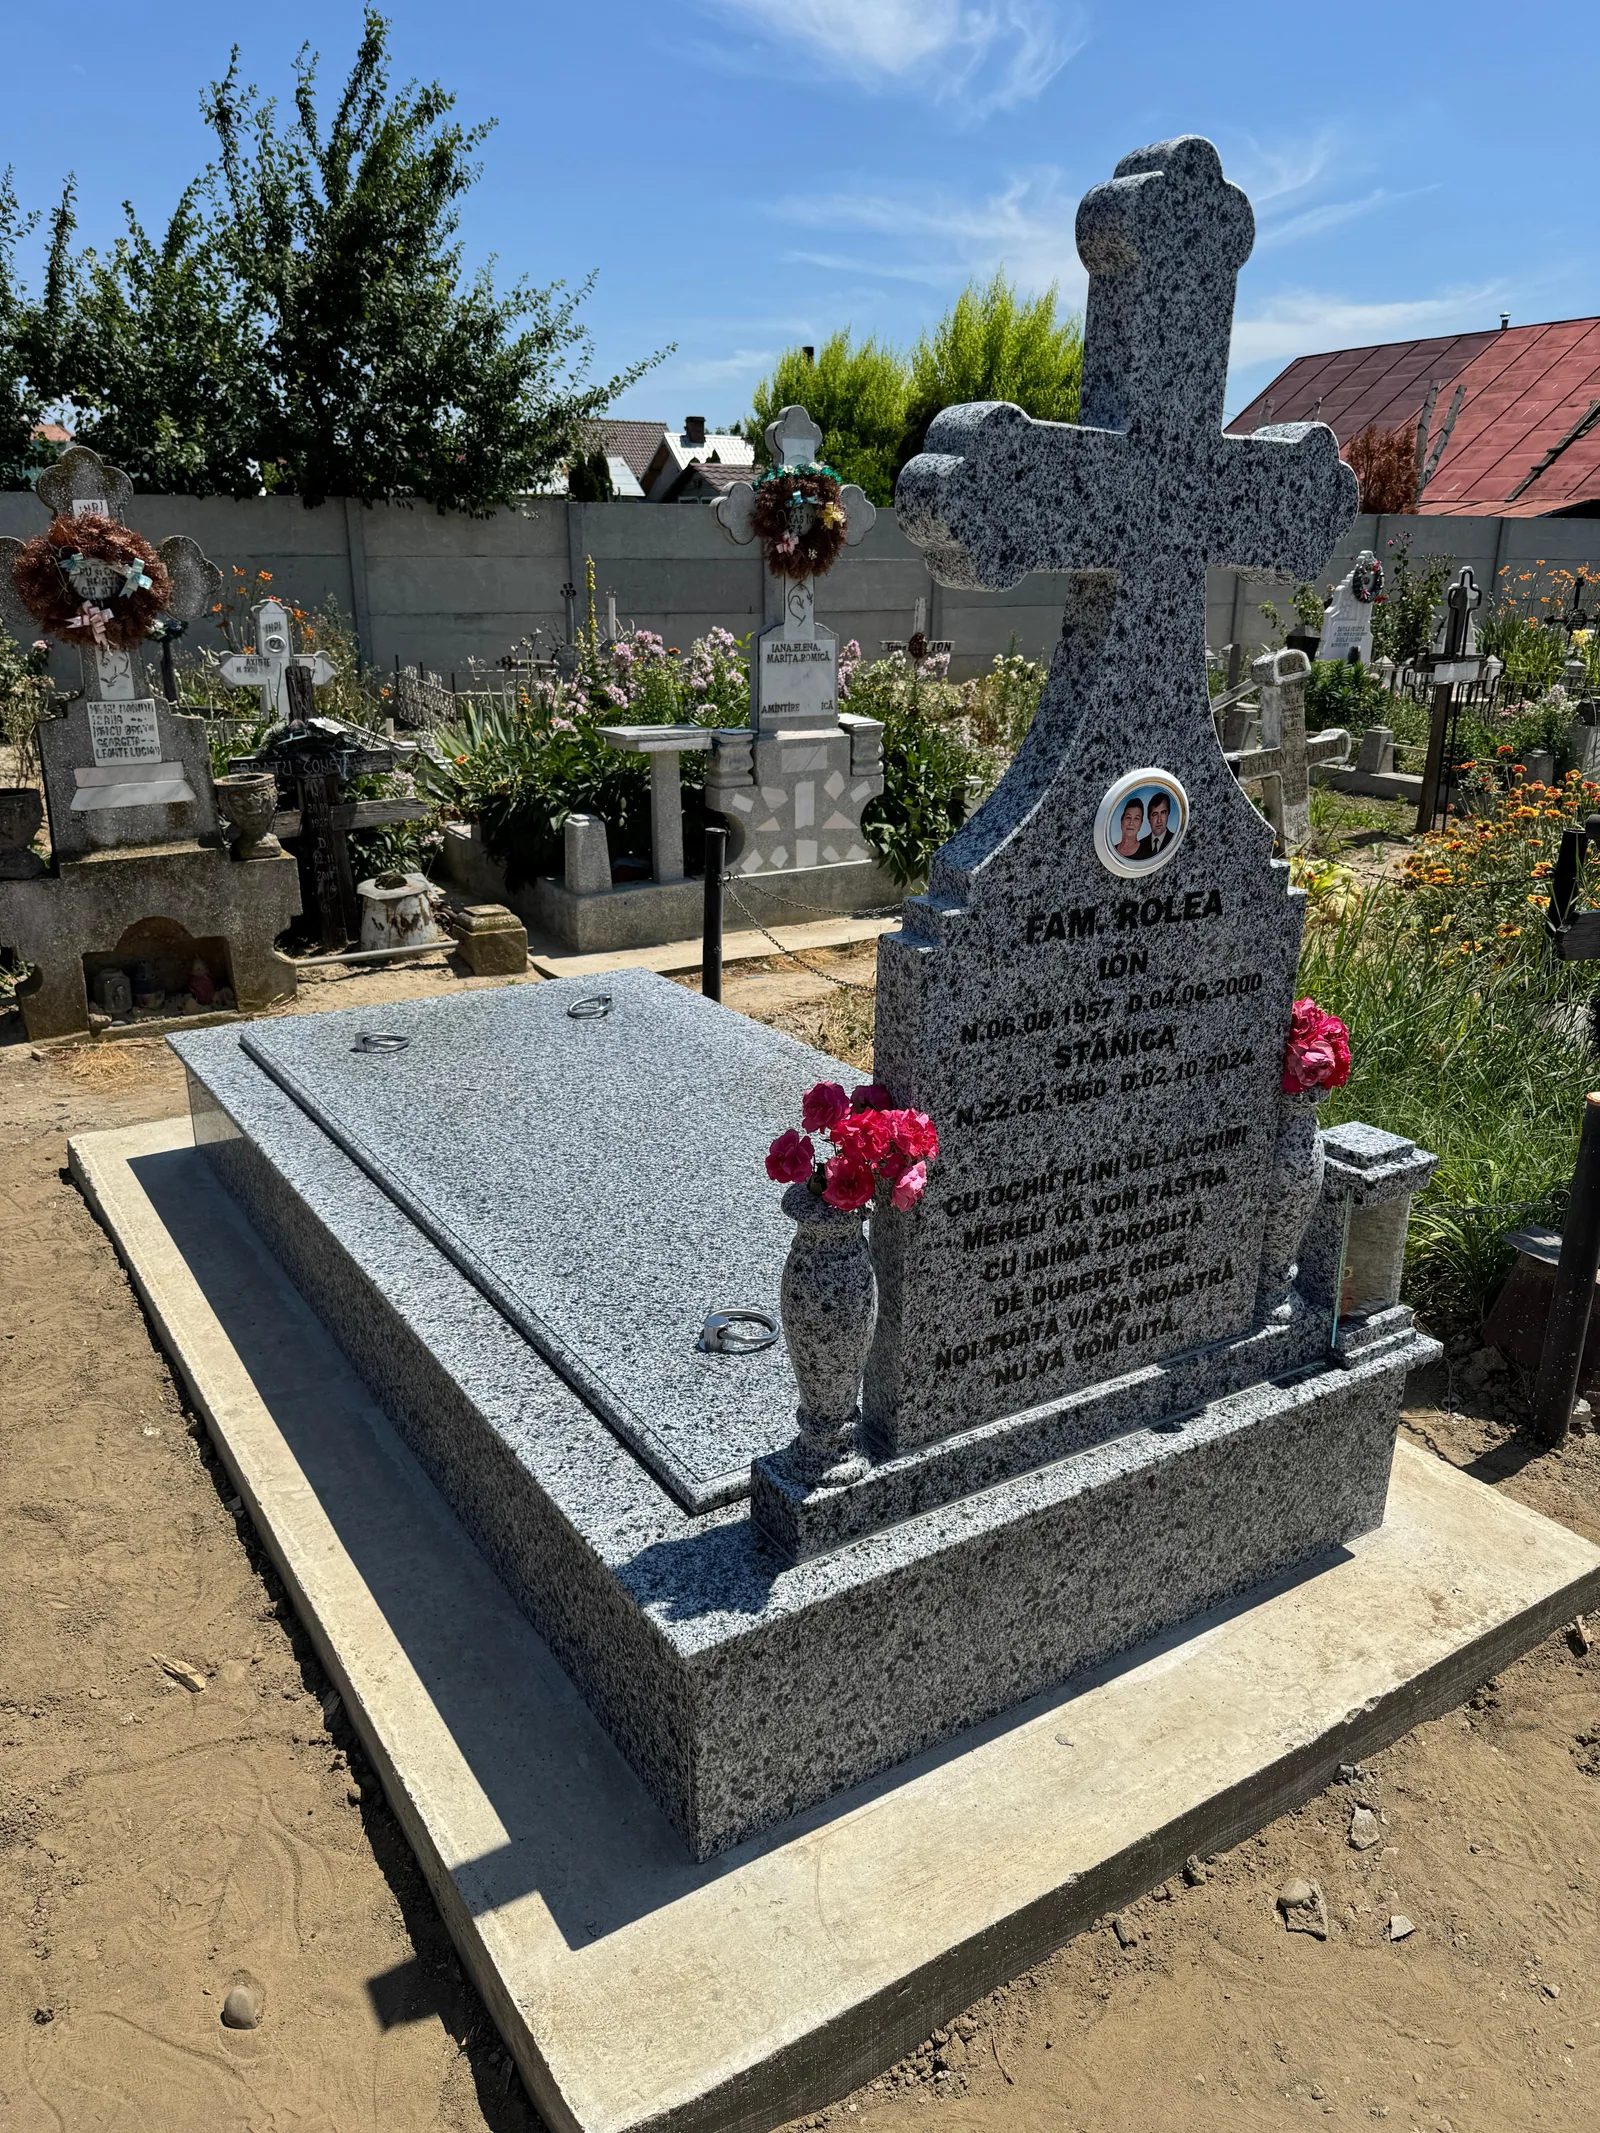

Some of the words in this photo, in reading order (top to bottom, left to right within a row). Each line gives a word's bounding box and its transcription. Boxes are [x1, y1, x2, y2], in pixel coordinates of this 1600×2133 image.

[1026, 906, 1104, 945] FAM.
[1116, 889, 1223, 931] ROLEA
[1098, 950, 1149, 981] ION
[944, 1190, 981, 1217] CU
[1062, 1157, 1121, 1189] PLINI
[1128, 1148, 1158, 1173] DE
[963, 1211, 1046, 1251] MEREU
[1092, 1188, 1139, 1217] VOM
[983, 1254, 1017, 1283] CU
[1025, 1238, 1090, 1272] INIMA
[994, 1291, 1025, 1318] DE
[1032, 1263, 1122, 1307] DURERE
[935, 1341, 978, 1372] NOI
[994, 1362, 1028, 1388] NU
[1072, 1331, 1120, 1362] VOM
